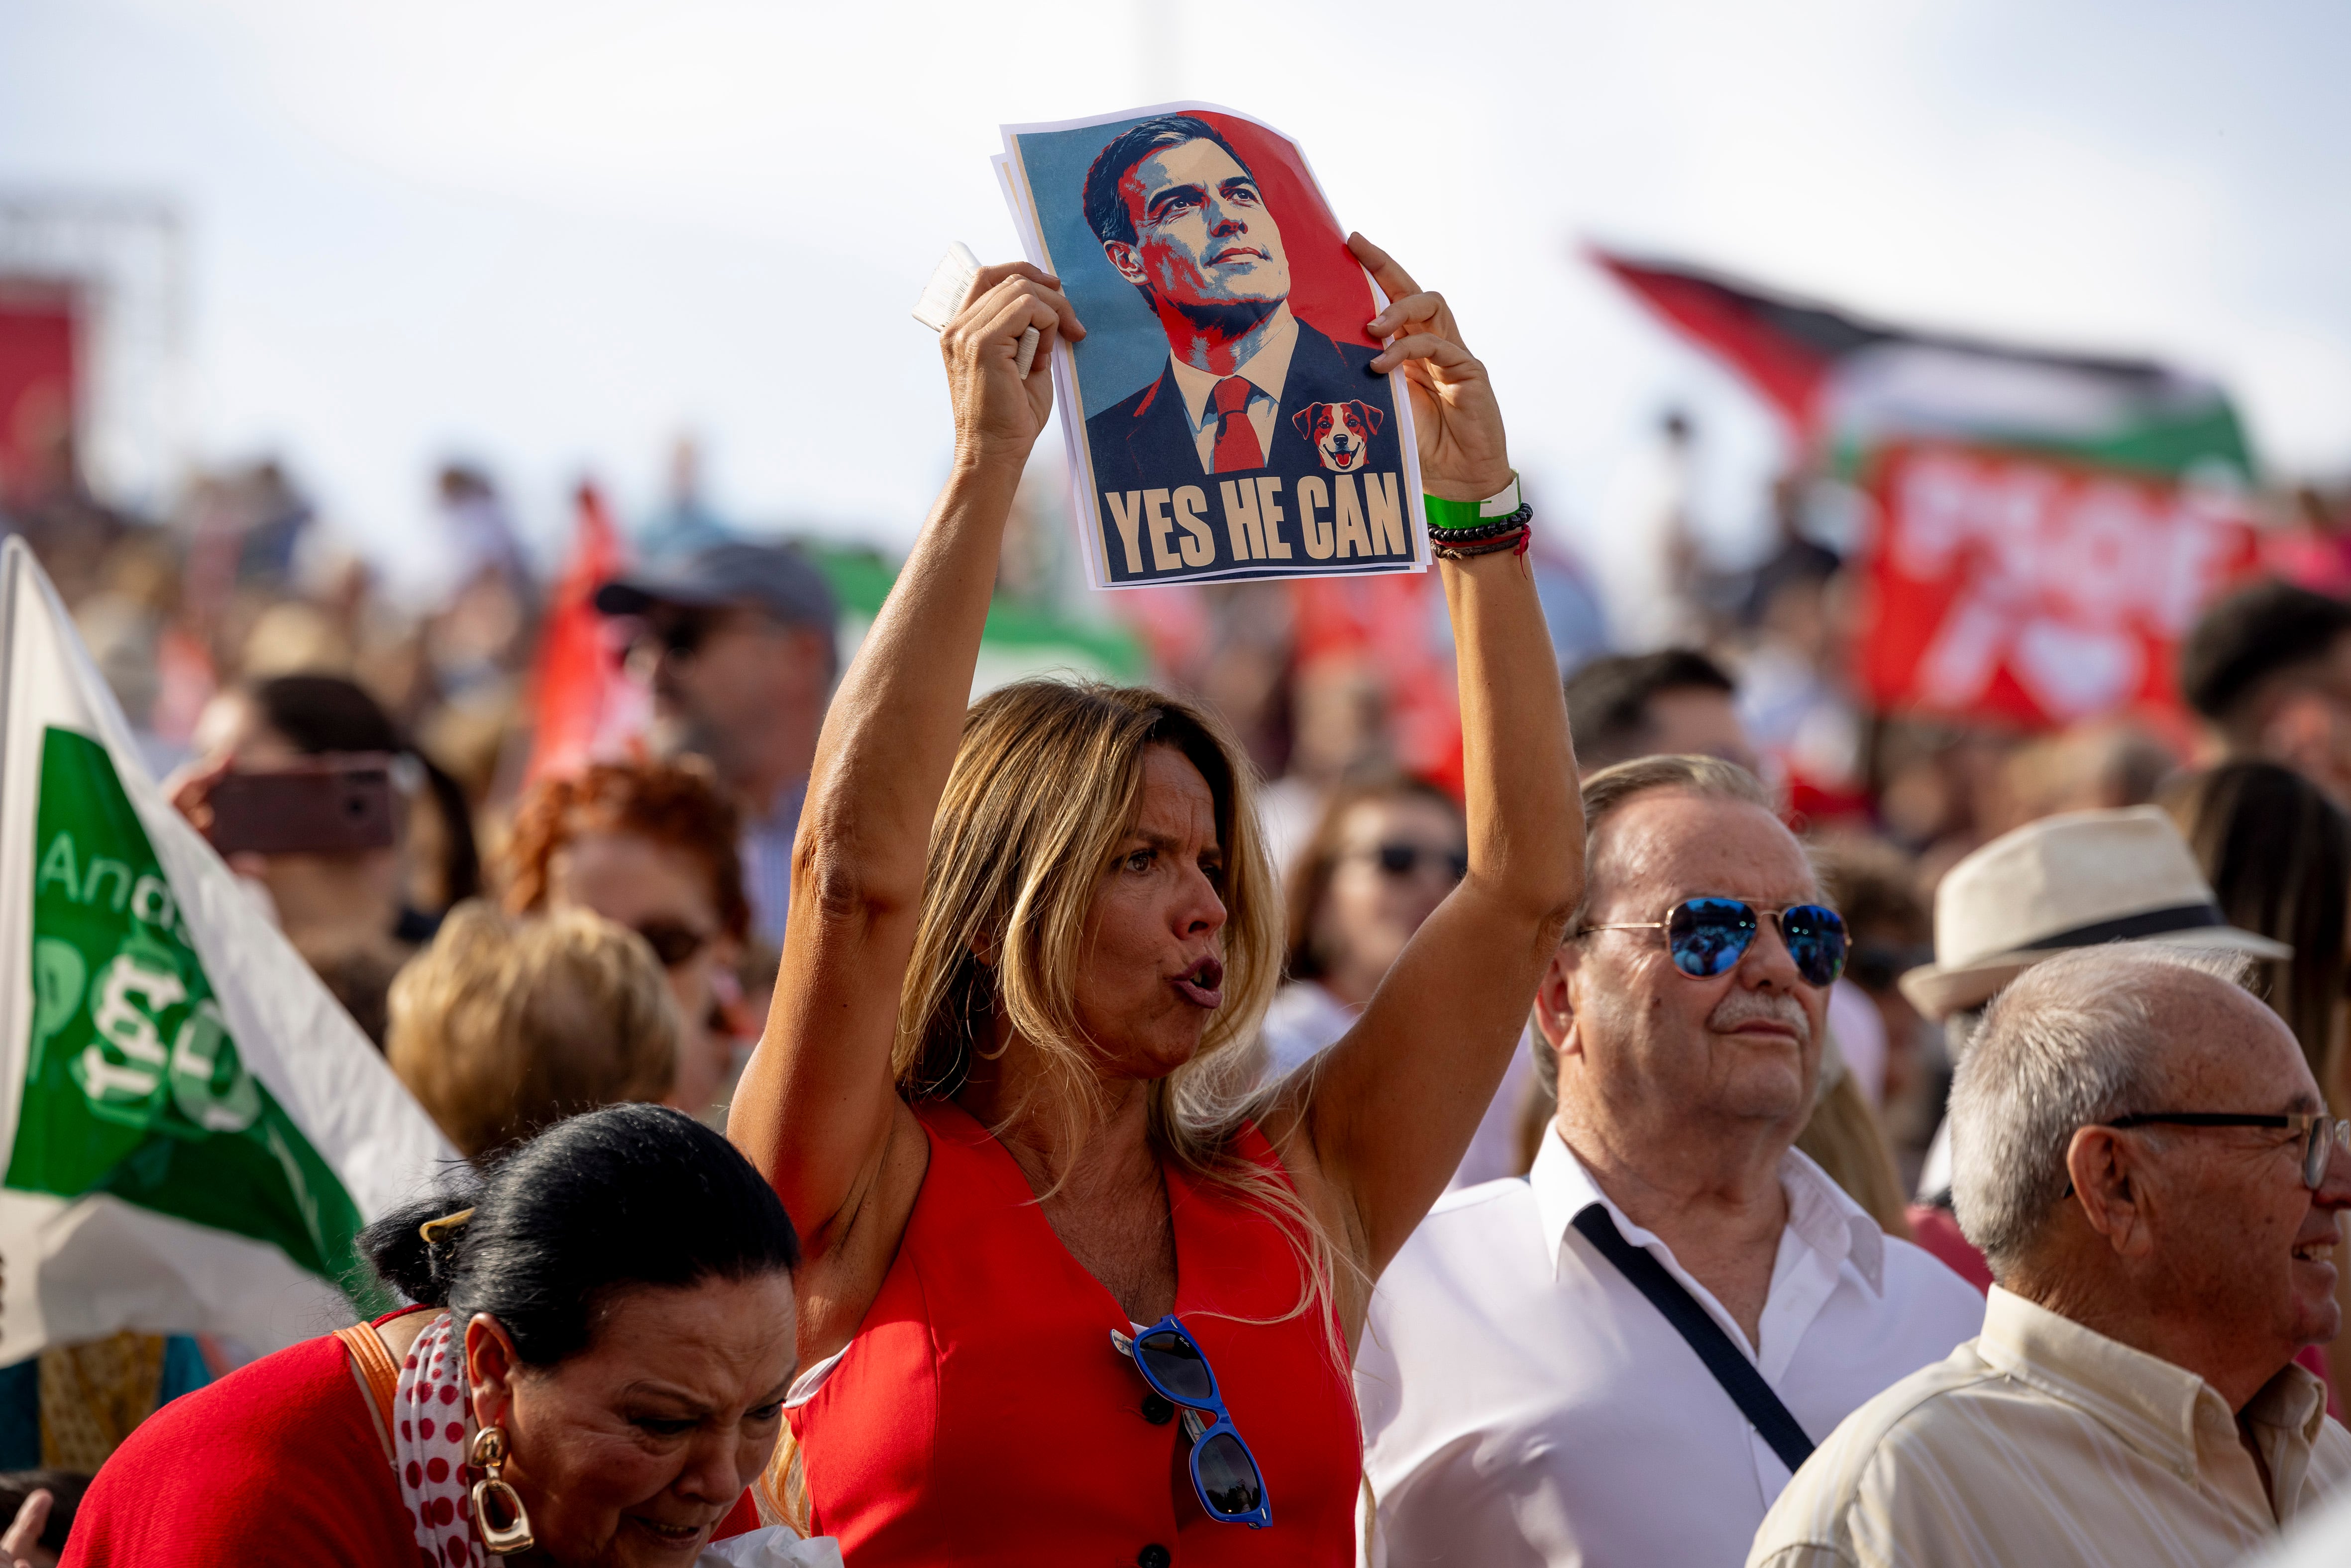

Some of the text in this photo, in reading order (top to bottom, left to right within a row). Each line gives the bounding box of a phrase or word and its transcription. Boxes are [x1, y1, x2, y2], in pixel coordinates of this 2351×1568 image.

[1105, 472, 1407, 573] YES HE CAN
